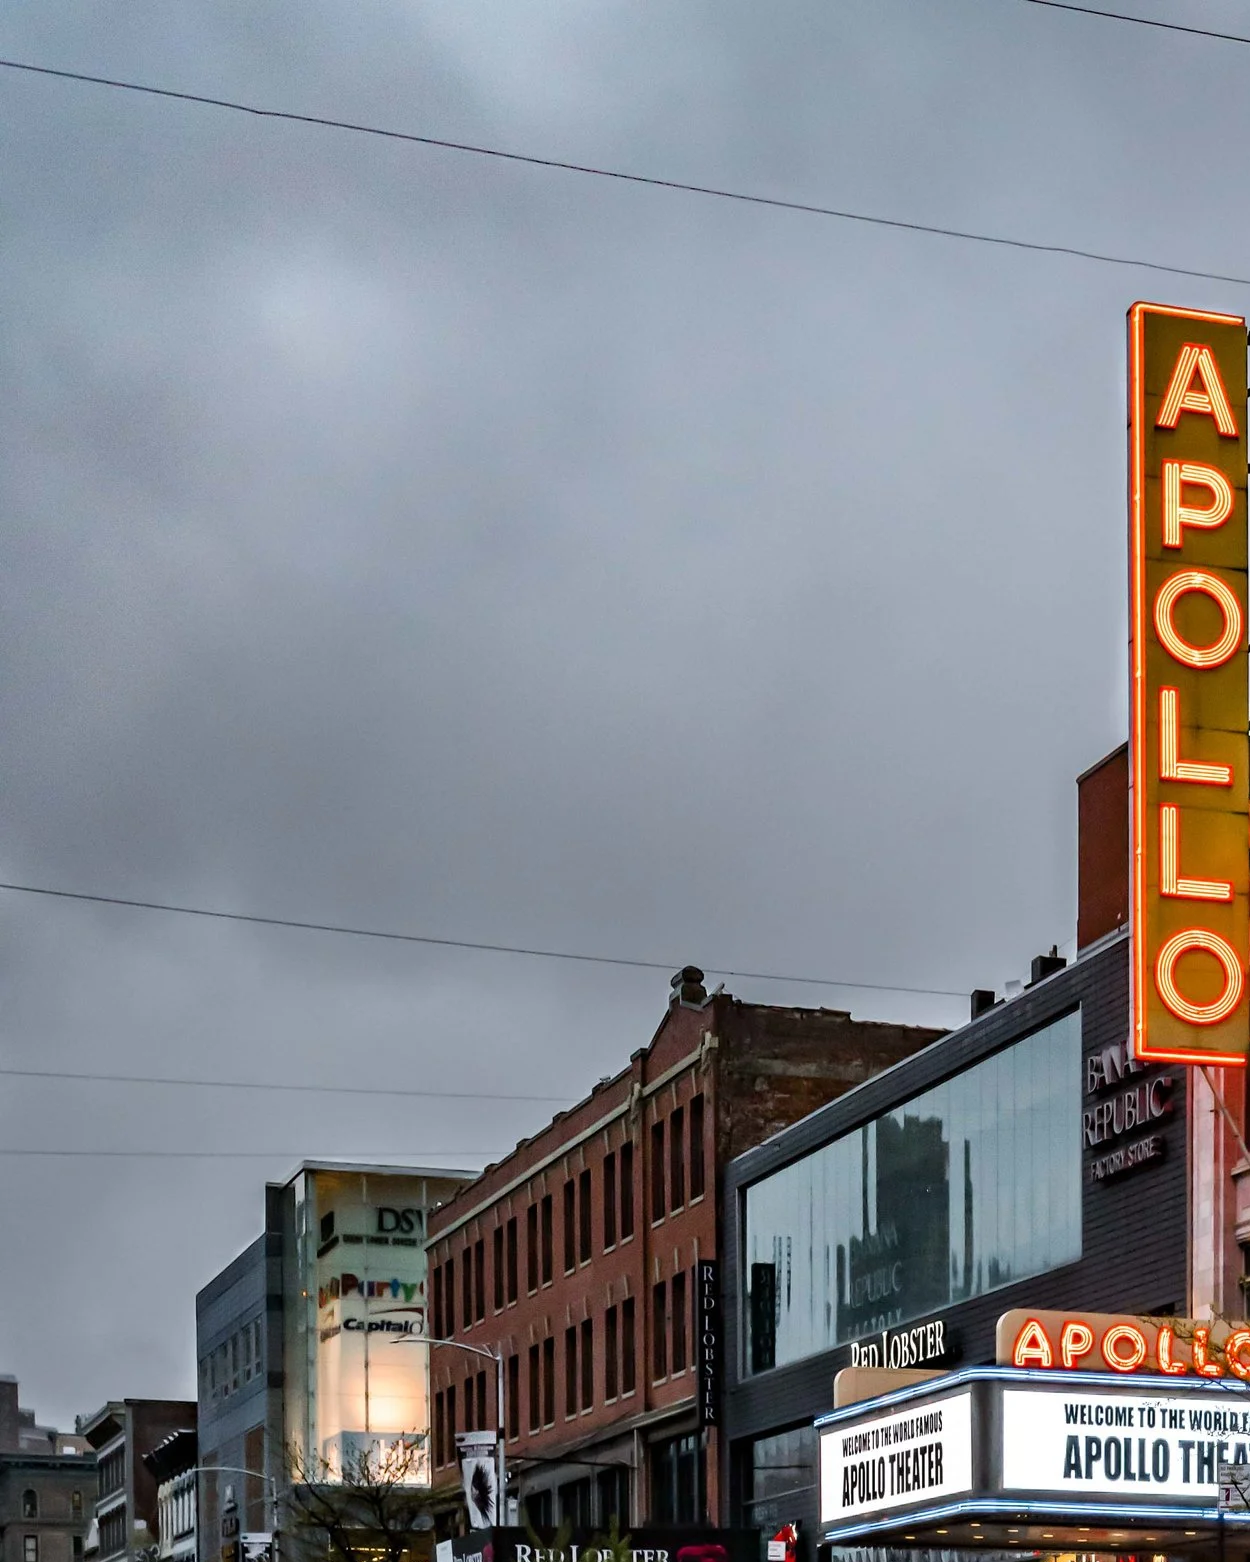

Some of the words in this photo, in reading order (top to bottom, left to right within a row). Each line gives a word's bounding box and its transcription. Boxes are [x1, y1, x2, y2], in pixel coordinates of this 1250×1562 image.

[1153, 342, 1247, 1027] APOLLO
[1083, 1077, 1172, 1149] REPUBLIC
[1090, 1150, 1125, 1181] FACTORY
[1127, 1136, 1163, 1167] STORE
[703, 1265, 715, 1310] RED
[703, 1315, 715, 1420] LOBSTER
[850, 1341, 879, 1368] RED
[882, 1320, 945, 1370] LOBSTER
[841, 1432, 871, 1458] WELCOME
[872, 1428, 880, 1450] TO
[880, 1425, 892, 1447] THE
[893, 1418, 915, 1443] WORLD
[915, 1409, 943, 1438] FAMOUS
[1064, 1403, 1135, 1428] WELCOME
[1138, 1406, 1156, 1429] TO
[1160, 1408, 1186, 1430] THE
[1189, 1409, 1239, 1432] WORLD
[841, 1456, 886, 1508] APOLLO
[888, 1441, 944, 1497] THEATER
[1063, 1434, 1170, 1484] APOLLO
